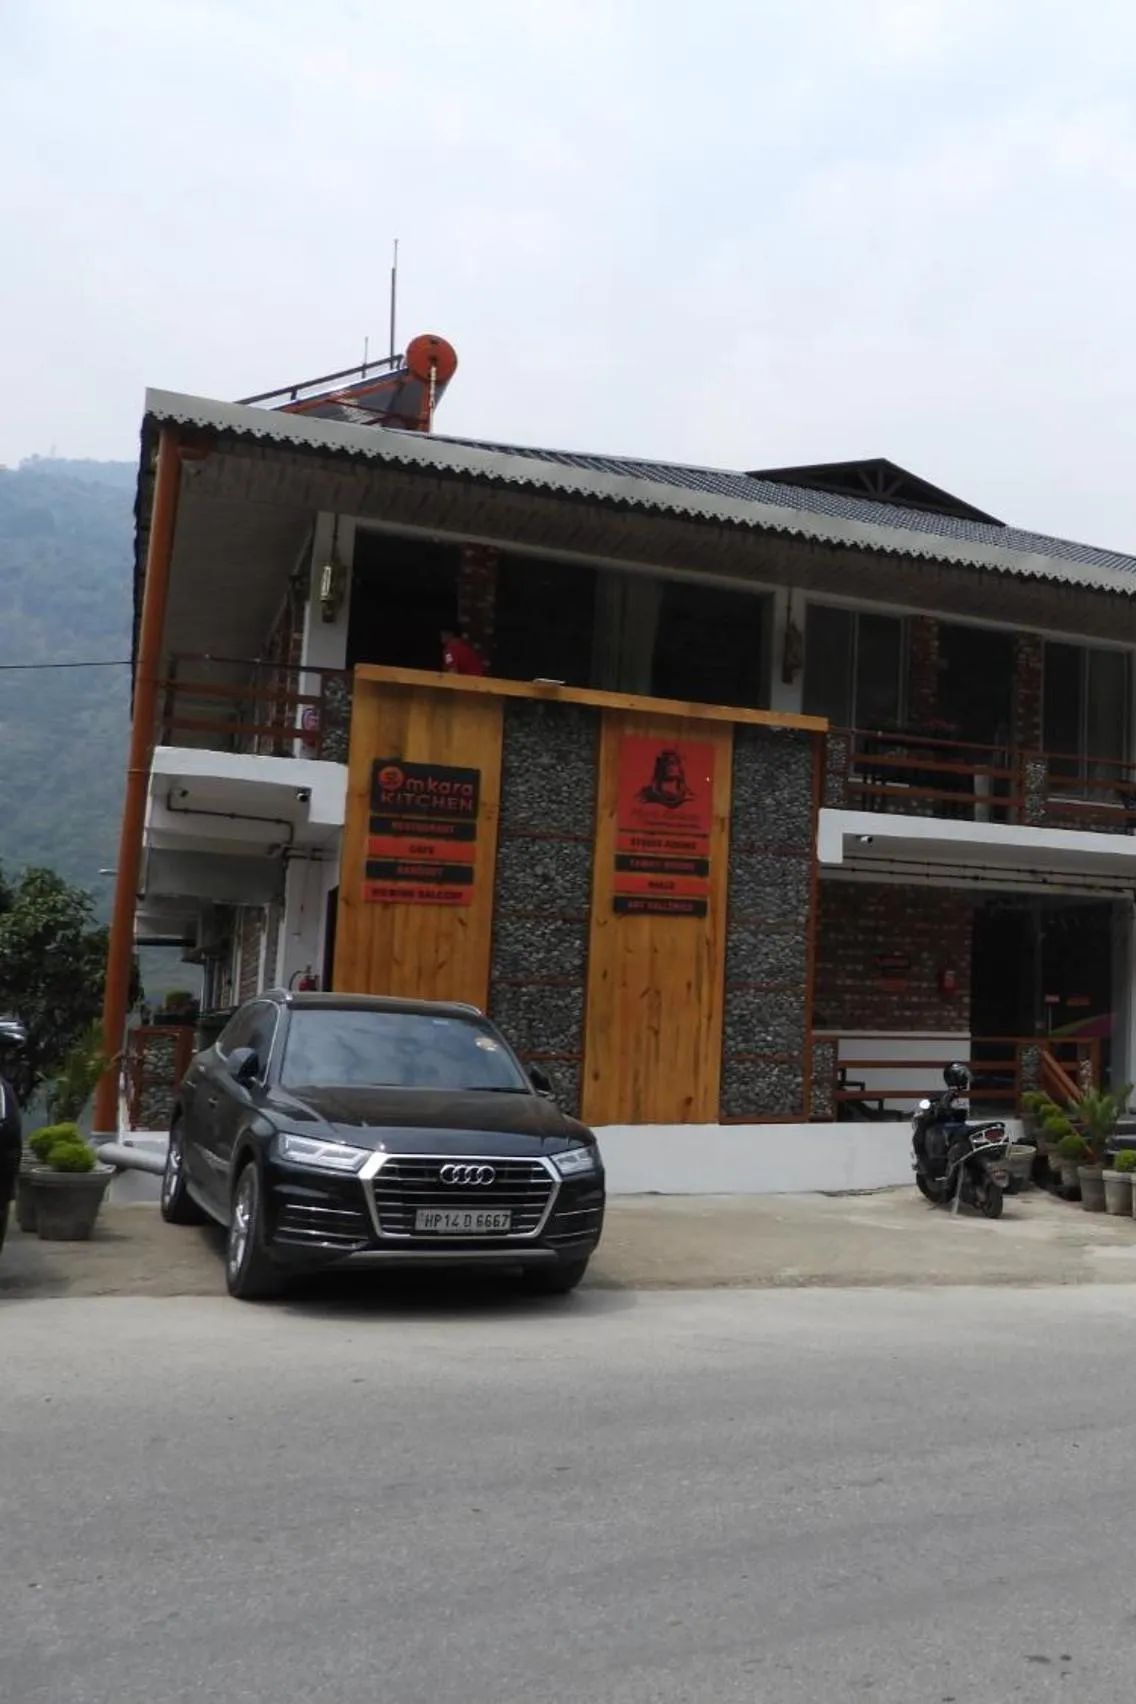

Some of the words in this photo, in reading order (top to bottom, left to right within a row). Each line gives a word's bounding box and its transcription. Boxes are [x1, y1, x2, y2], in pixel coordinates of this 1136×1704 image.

[381, 792, 473, 811] KITCHEN
[463, 1214, 472, 1228] D
[476, 1214, 509, 1229] 6667
